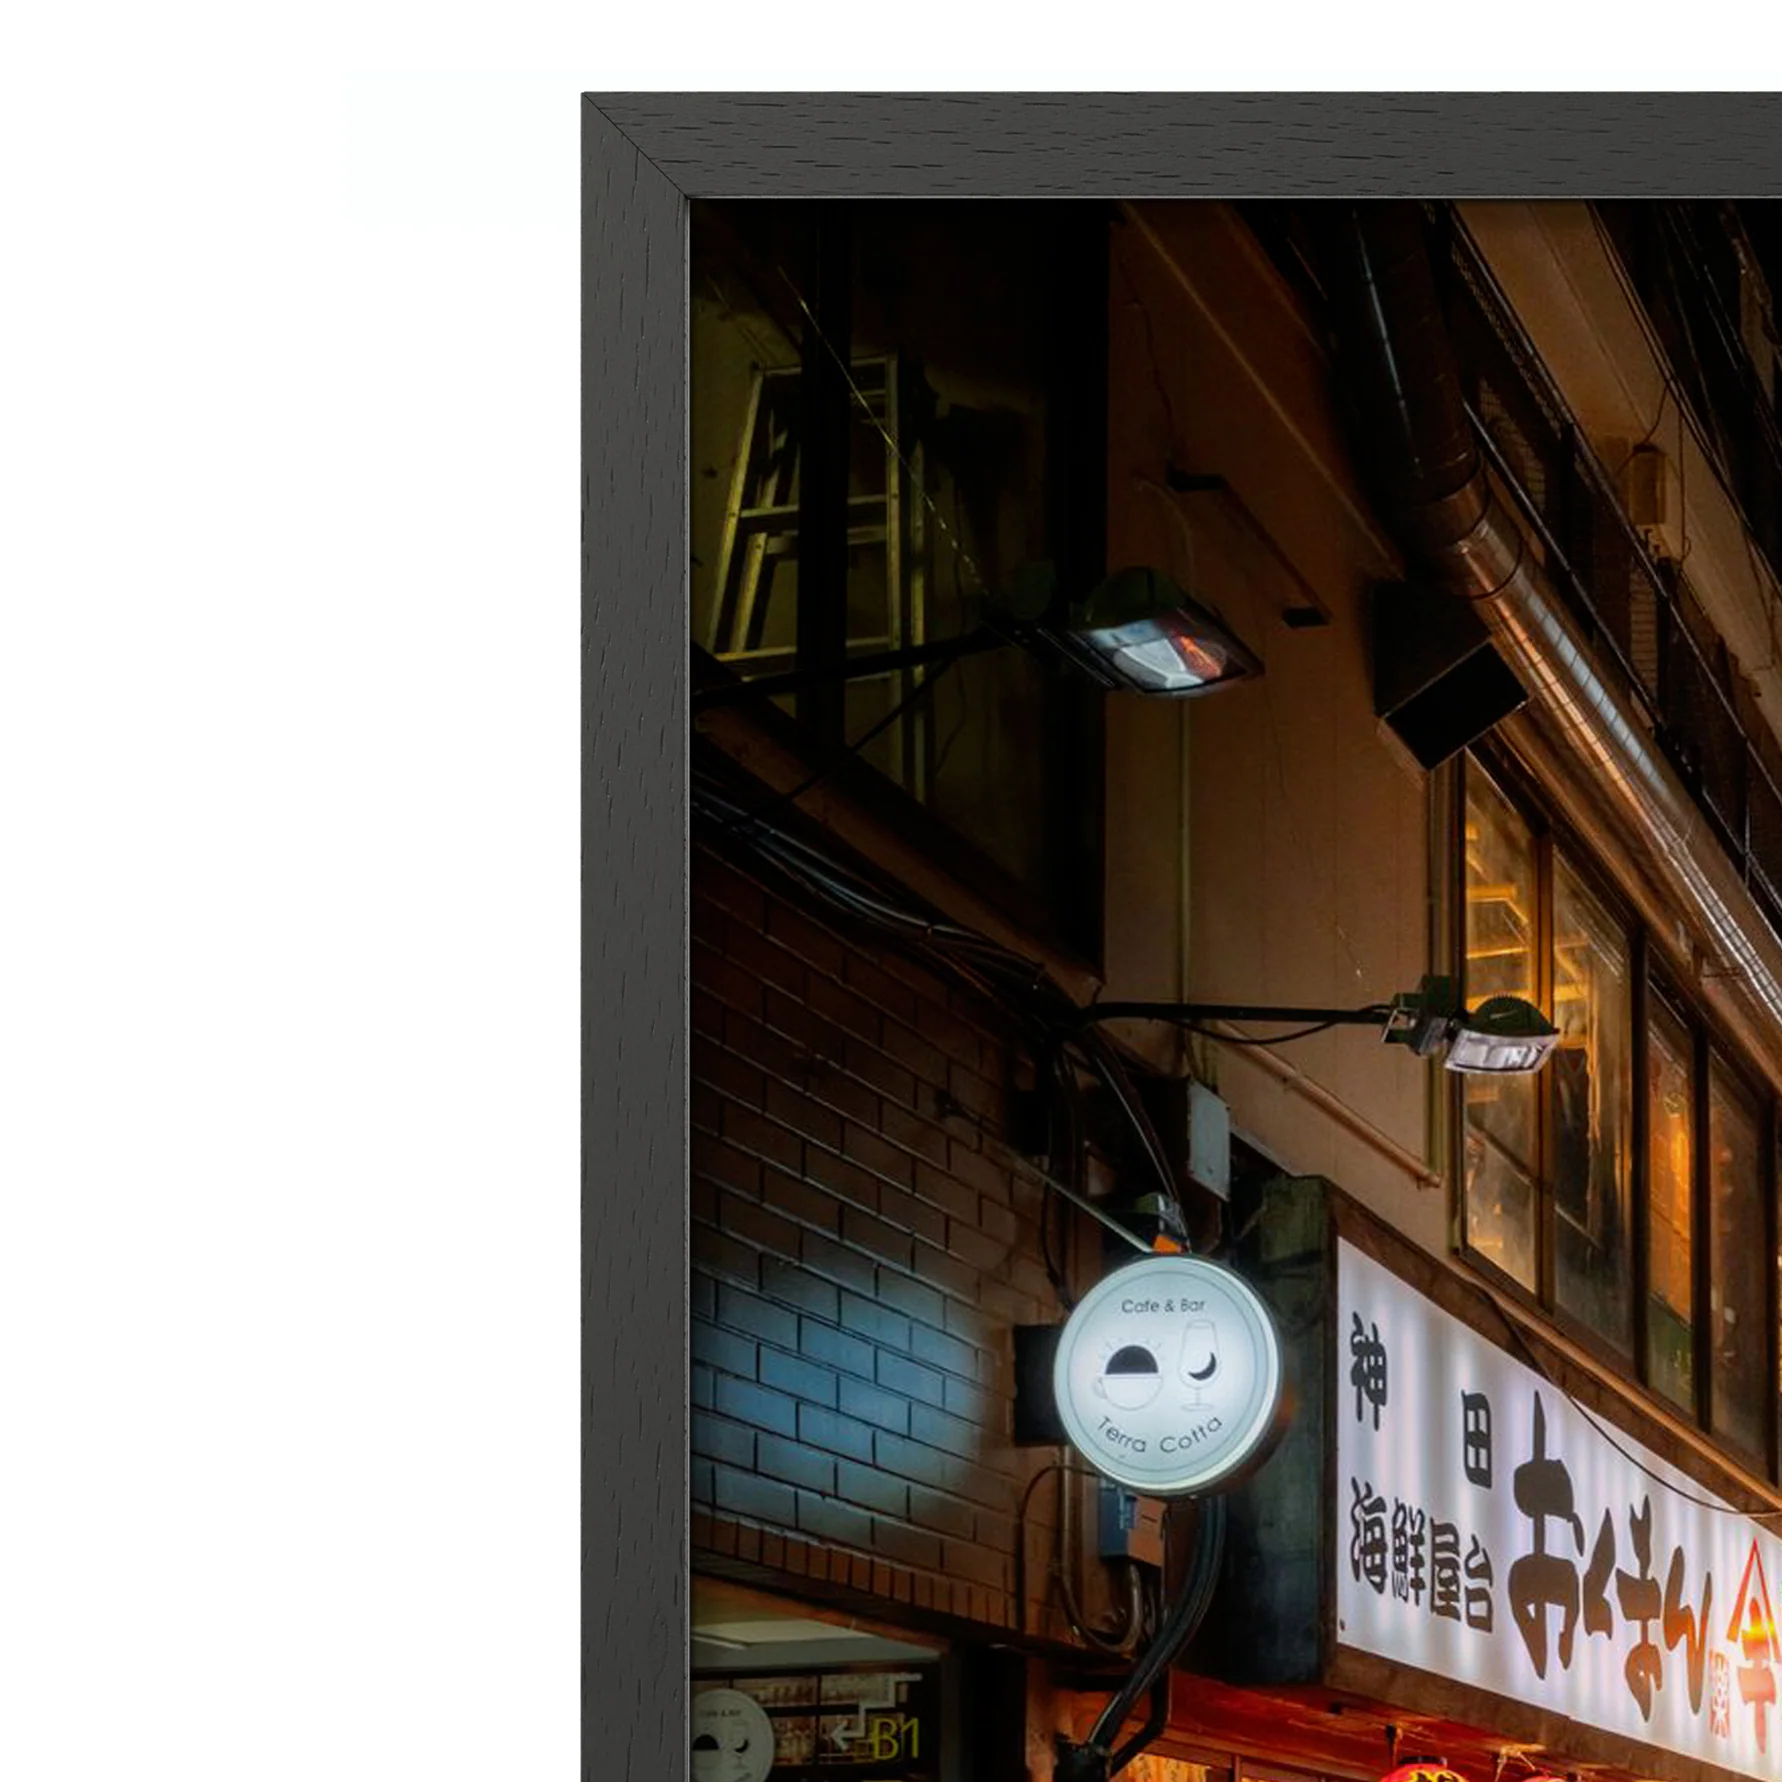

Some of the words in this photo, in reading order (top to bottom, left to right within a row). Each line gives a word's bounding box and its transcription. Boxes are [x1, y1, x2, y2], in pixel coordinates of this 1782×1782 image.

[1121, 1298, 1160, 1314] Cafe
[1164, 1299, 1176, 1314] &
[1180, 1299, 1206, 1314] Bar
[1097, 1415, 1148, 1454] Terra
[1159, 1414, 1223, 1455] Cotta
[1350, 1476, 1494, 1634] 海鮮屋台
[872, 1717, 919, 1761] B1
